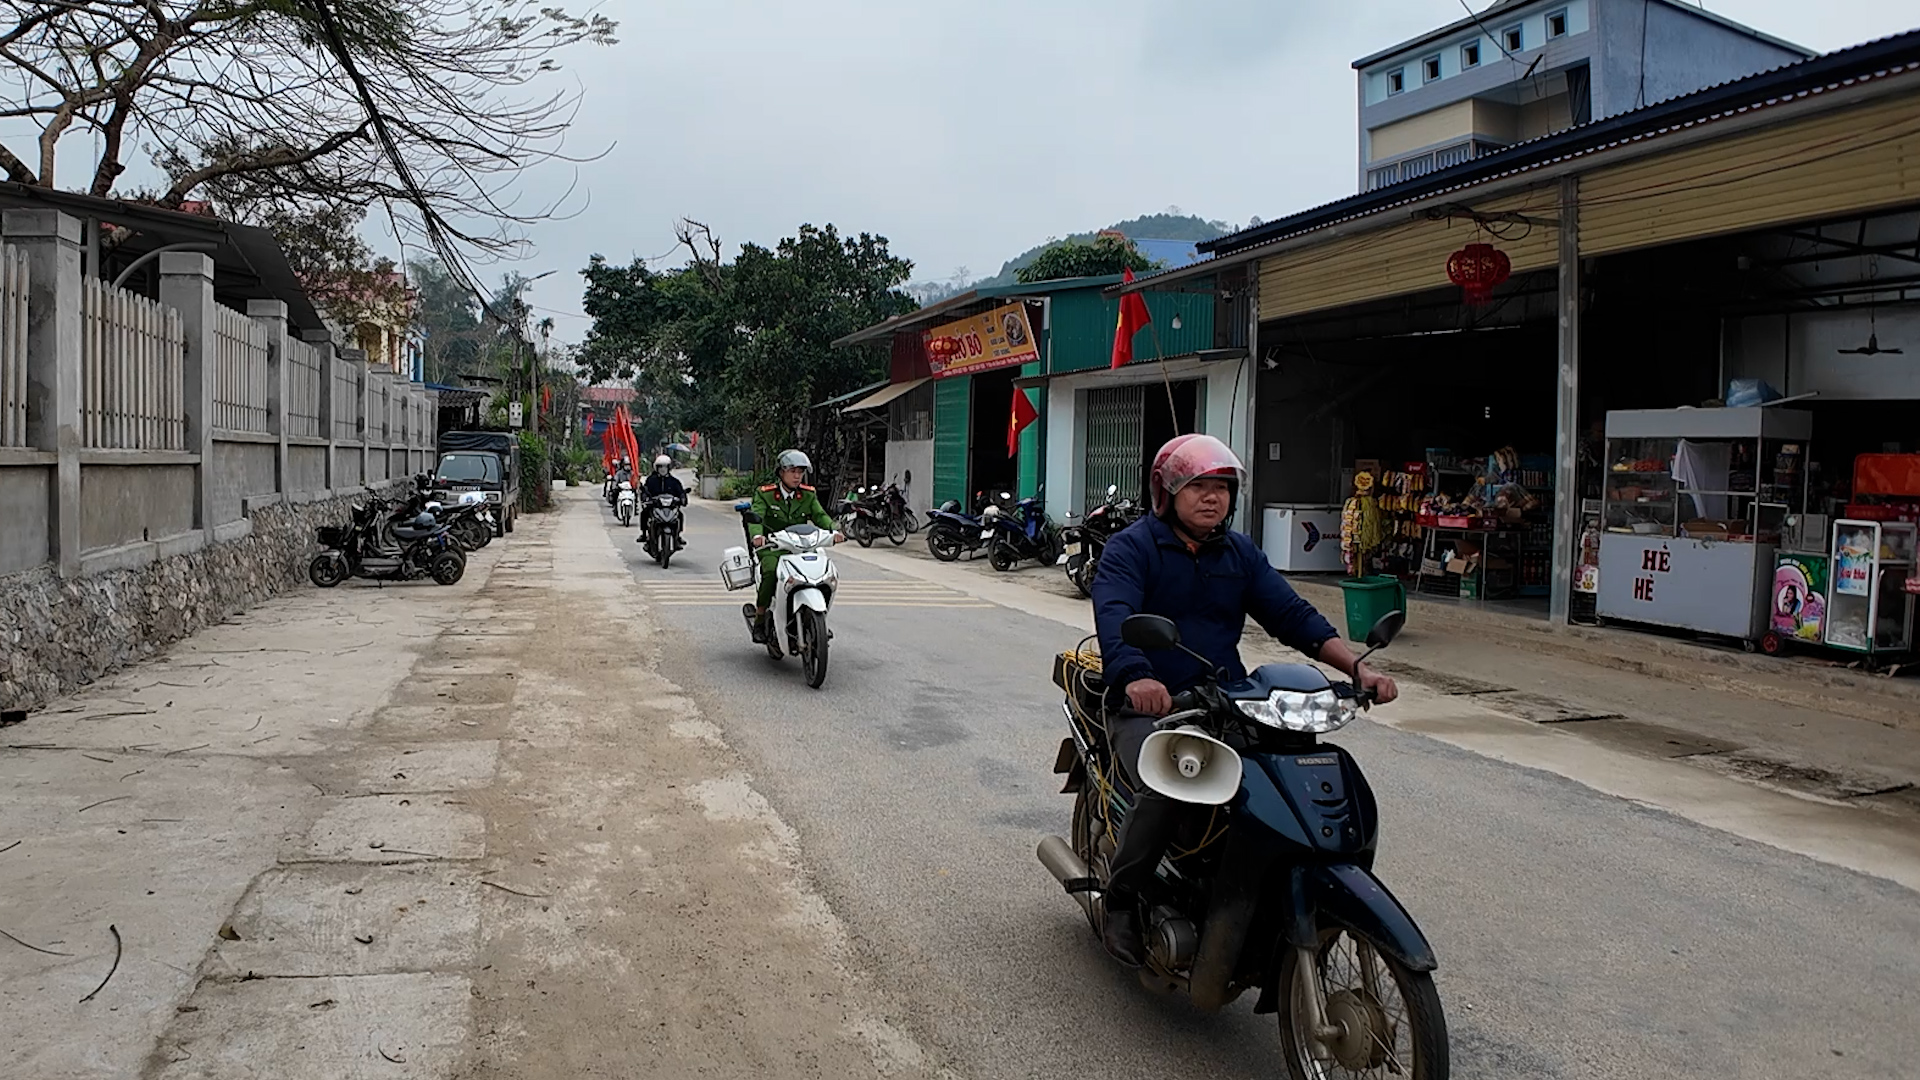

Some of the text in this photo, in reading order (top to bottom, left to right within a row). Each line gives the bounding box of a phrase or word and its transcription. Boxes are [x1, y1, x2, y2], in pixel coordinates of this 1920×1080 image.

[1641, 544, 1671, 573] HÈ
[1633, 573, 1655, 602] HÈ
[1297, 757, 1337, 766] HONDA
